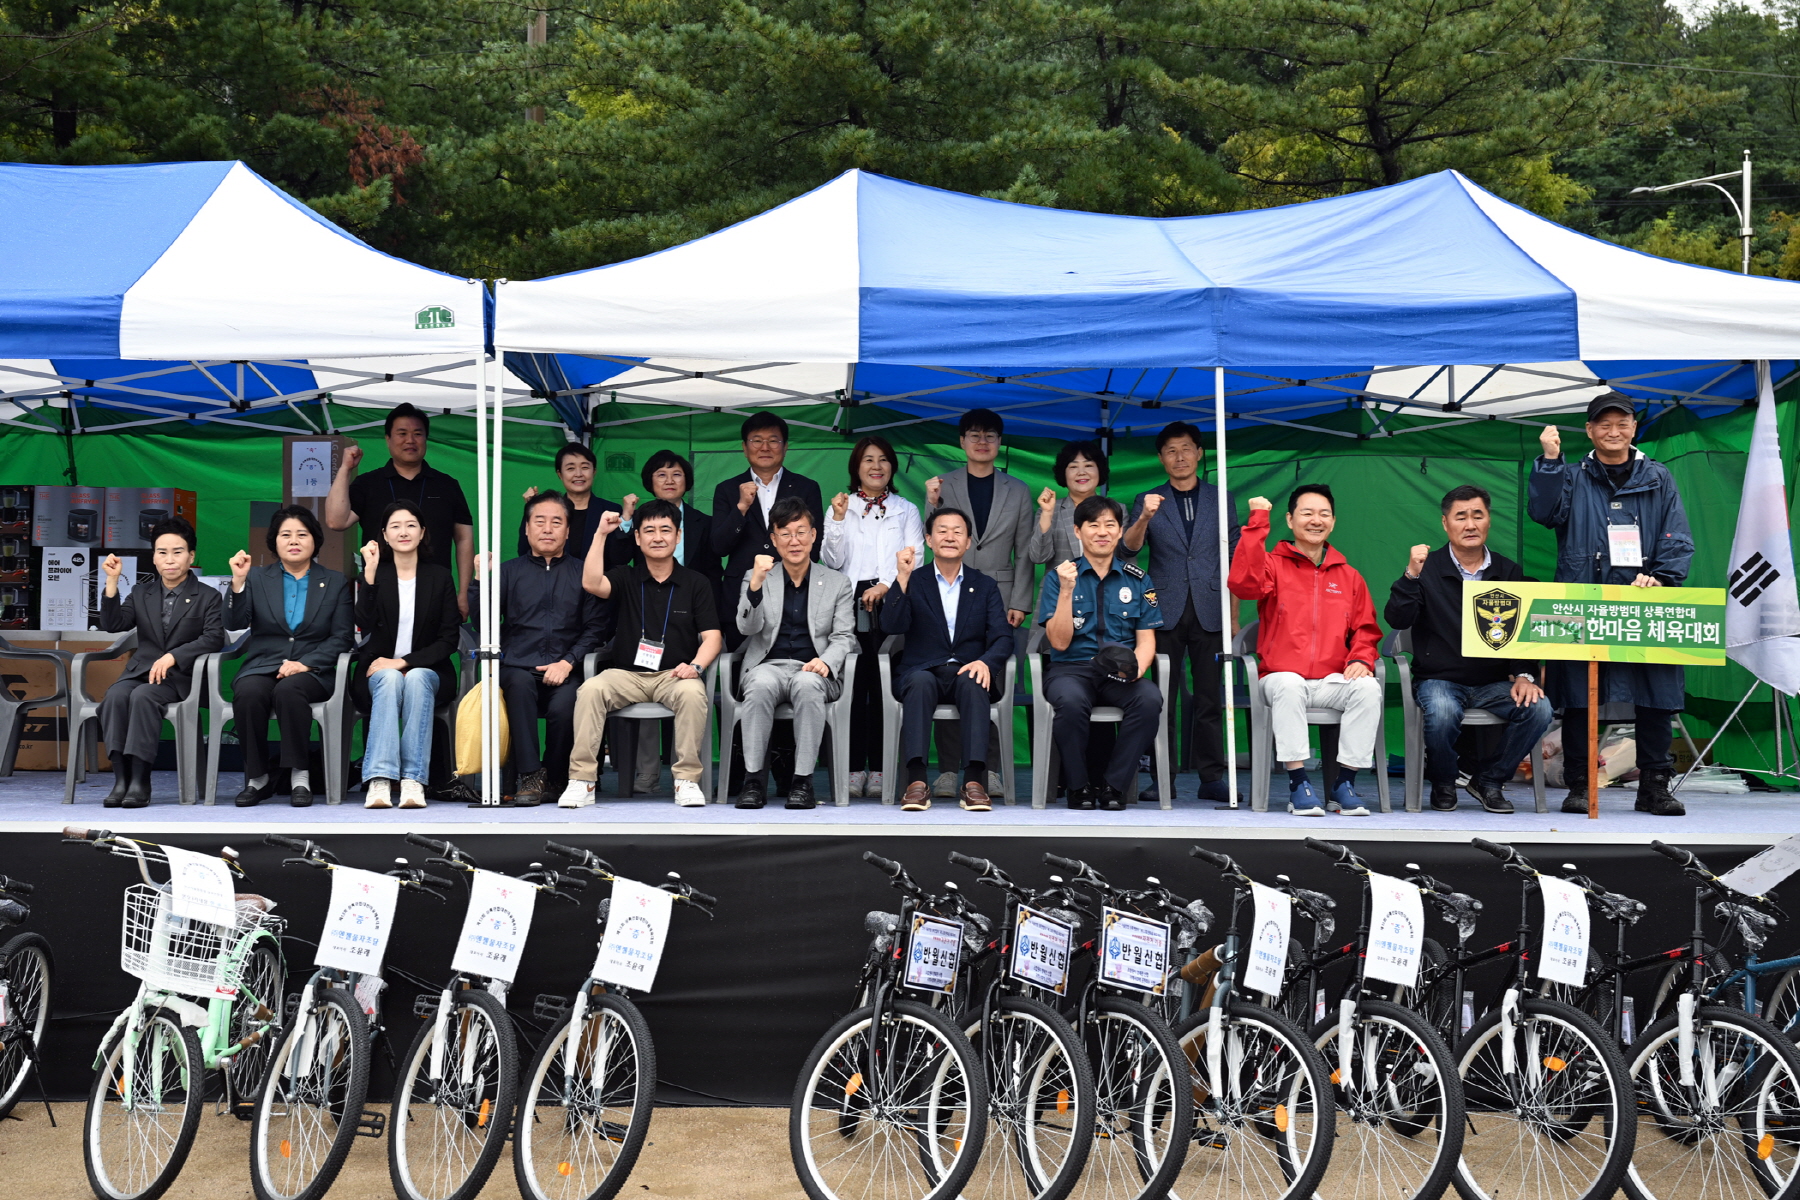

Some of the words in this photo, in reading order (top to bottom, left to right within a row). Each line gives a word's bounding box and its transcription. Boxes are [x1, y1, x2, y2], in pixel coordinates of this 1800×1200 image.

[1552, 604, 1583, 615] 안산시
[1587, 605, 1640, 617] 자율방범대
[1643, 606, 1696, 619] 상록연합대
[1587, 617, 1642, 642] 한마음
[1647, 620, 1719, 644] 체육대회
[923, 947, 955, 969] 반월신협
[1030, 941, 1065, 970] 반월신협
[1122, 943, 1163, 970] 반월신협
